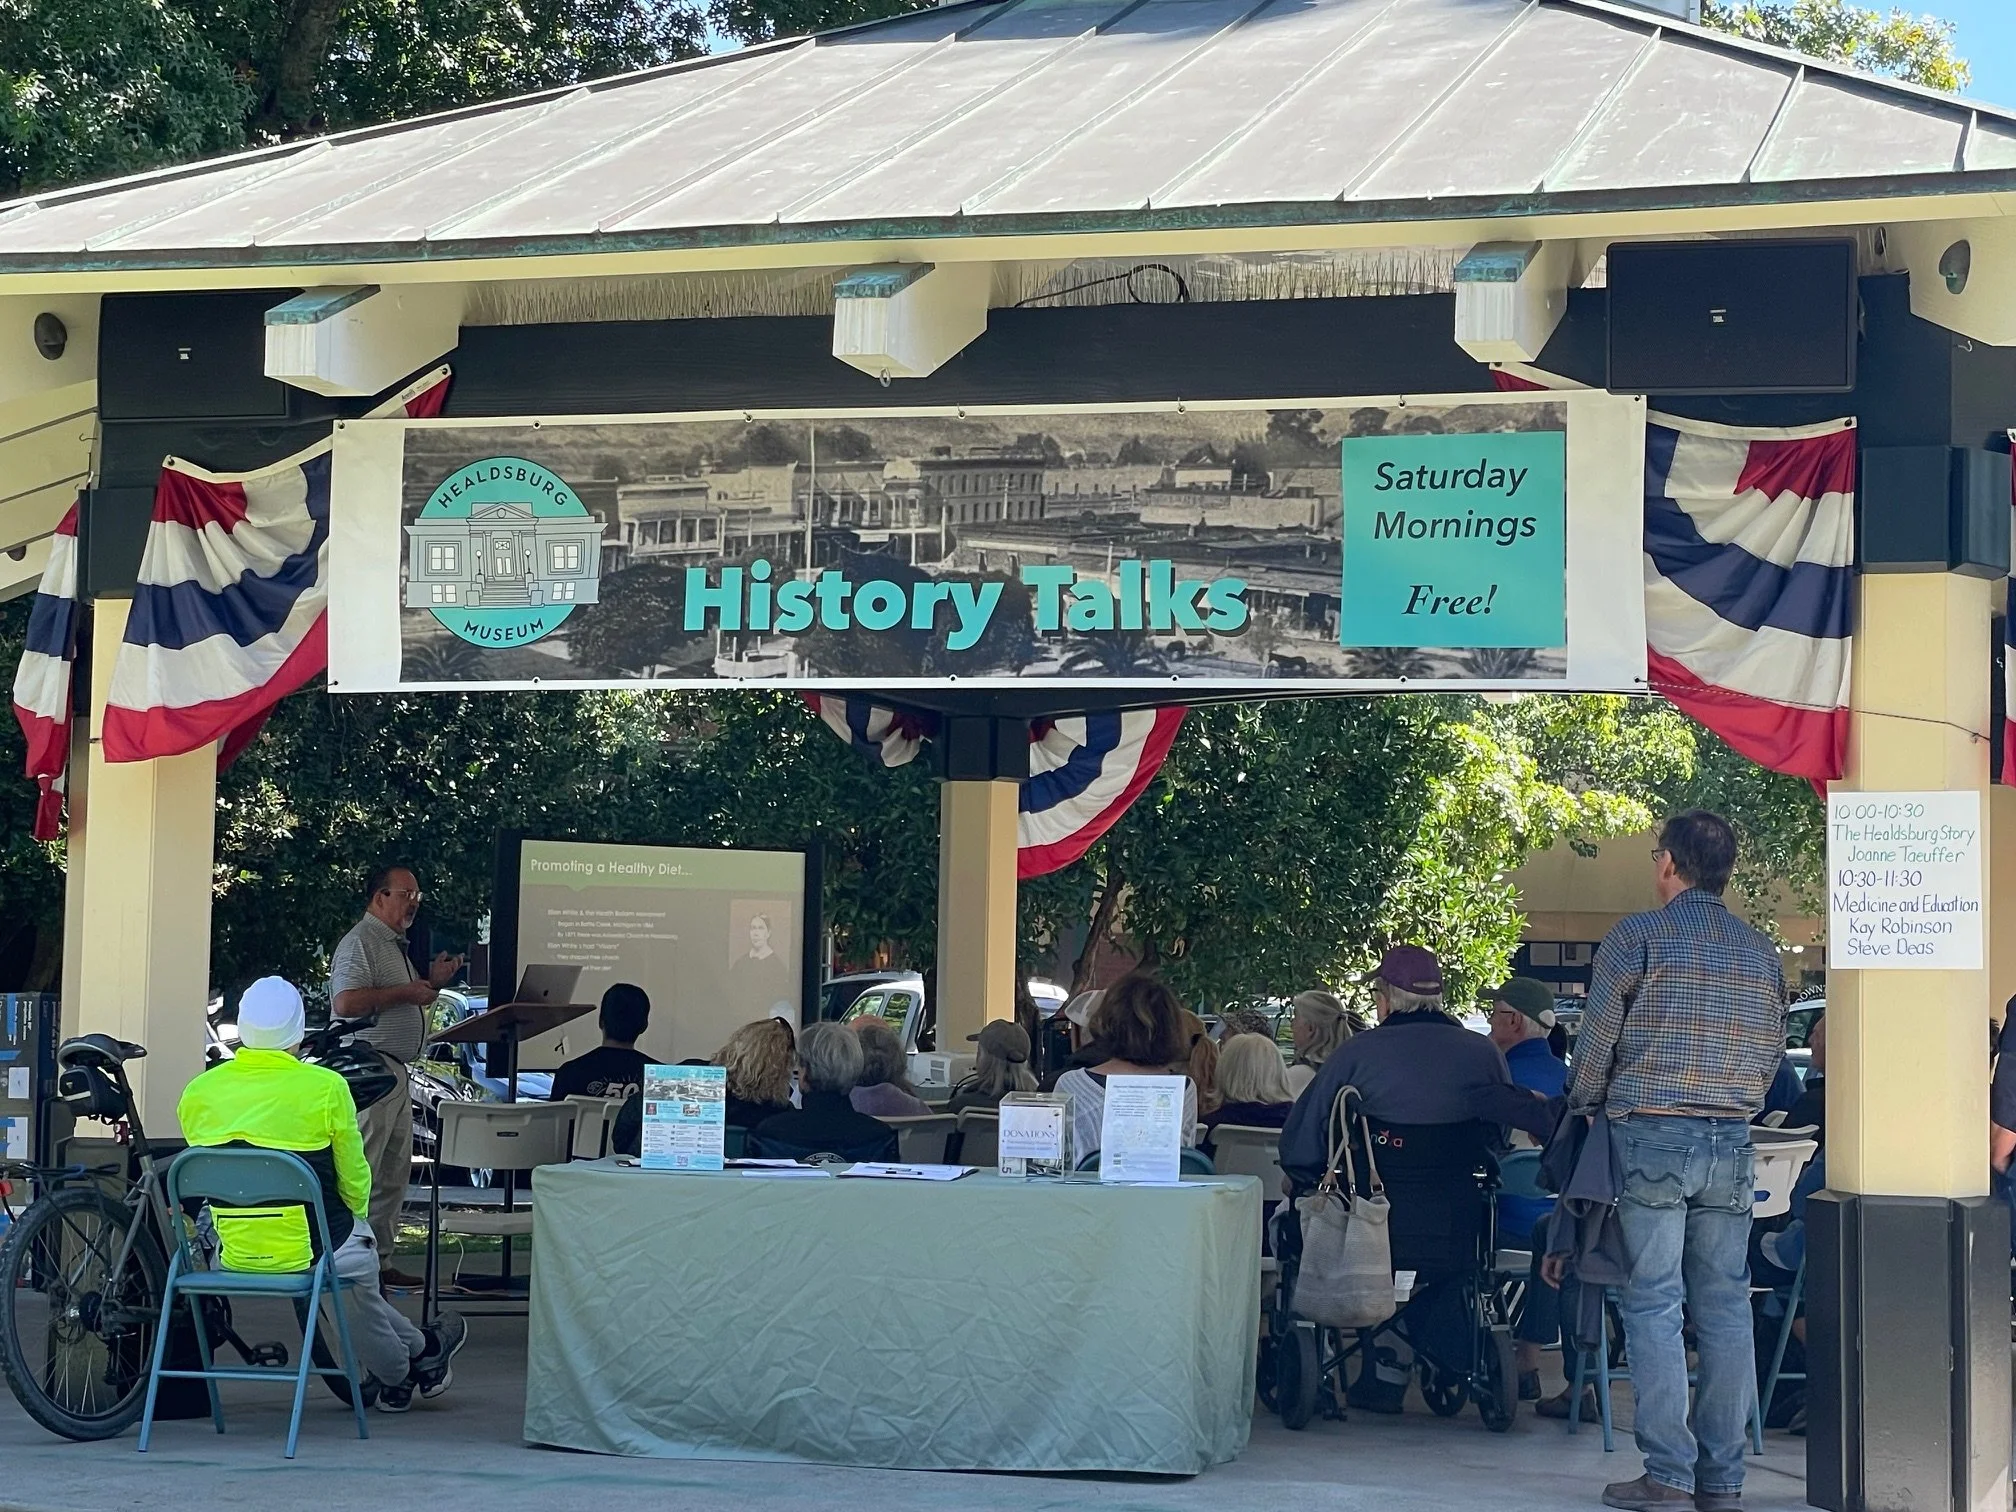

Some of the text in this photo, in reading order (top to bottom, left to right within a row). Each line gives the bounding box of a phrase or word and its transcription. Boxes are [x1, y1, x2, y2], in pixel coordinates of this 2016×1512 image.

[438, 466, 568, 509] HEALDSBURG
[1374, 458, 1529, 497] Saturday
[1374, 509, 1537, 546] Mornings
[683, 558, 1250, 651] History Talks
[1401, 584, 1498, 615] Free!
[464, 618, 544, 641] MUSEUM
[1832, 824, 1976, 846] The Healdsburg Story
[1847, 845, 1966, 863] Joanne Taeuffer
[530, 859, 593, 876] Promoting
[597, 864, 605, 873] a
[609, 861, 655, 877] Healthy
[1838, 870, 1922, 888] 10:30-11:30
[1833, 891, 1979, 913] Medicine and Education
[1849, 916, 1953, 941] Kay Robinson
[1847, 938, 1934, 956] Steve Deas
[1003, 1129, 1055, 1139] DONATIONS
